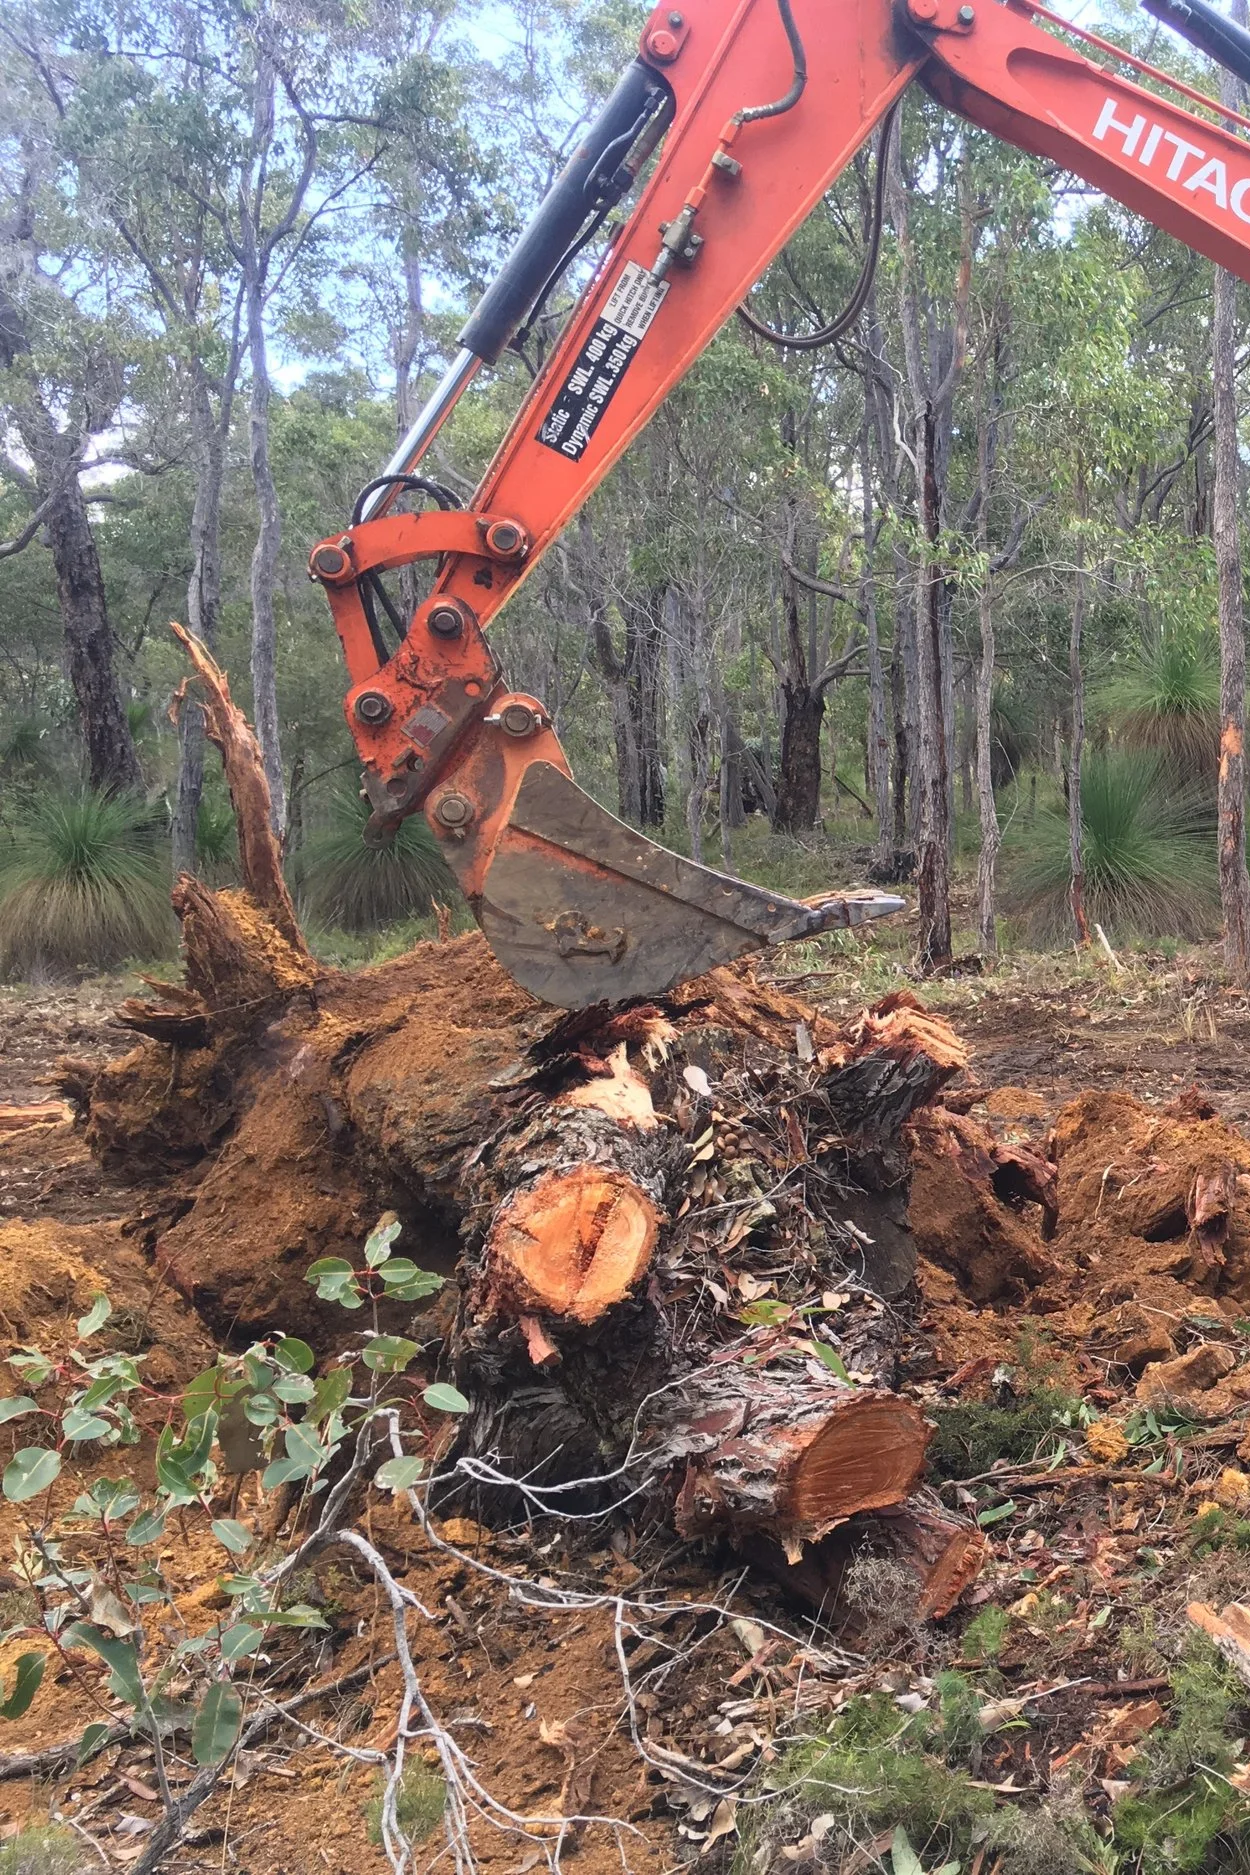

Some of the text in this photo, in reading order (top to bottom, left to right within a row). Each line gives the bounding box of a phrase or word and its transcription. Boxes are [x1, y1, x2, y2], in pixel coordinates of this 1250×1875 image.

[609, 274, 631, 307] LIFT FROM
[614, 304, 628, 324] QUICK
[624, 285, 638, 304] HITCH
[626, 302, 643, 328] REMOVE
[638, 311, 651, 329] WHEN
[595, 322, 618, 341] kg
[585, 338, 607, 363] 400
[561, 404, 599, 456] Dynamic
[616, 334, 638, 353] kg
[545, 409, 570, 443] Static
